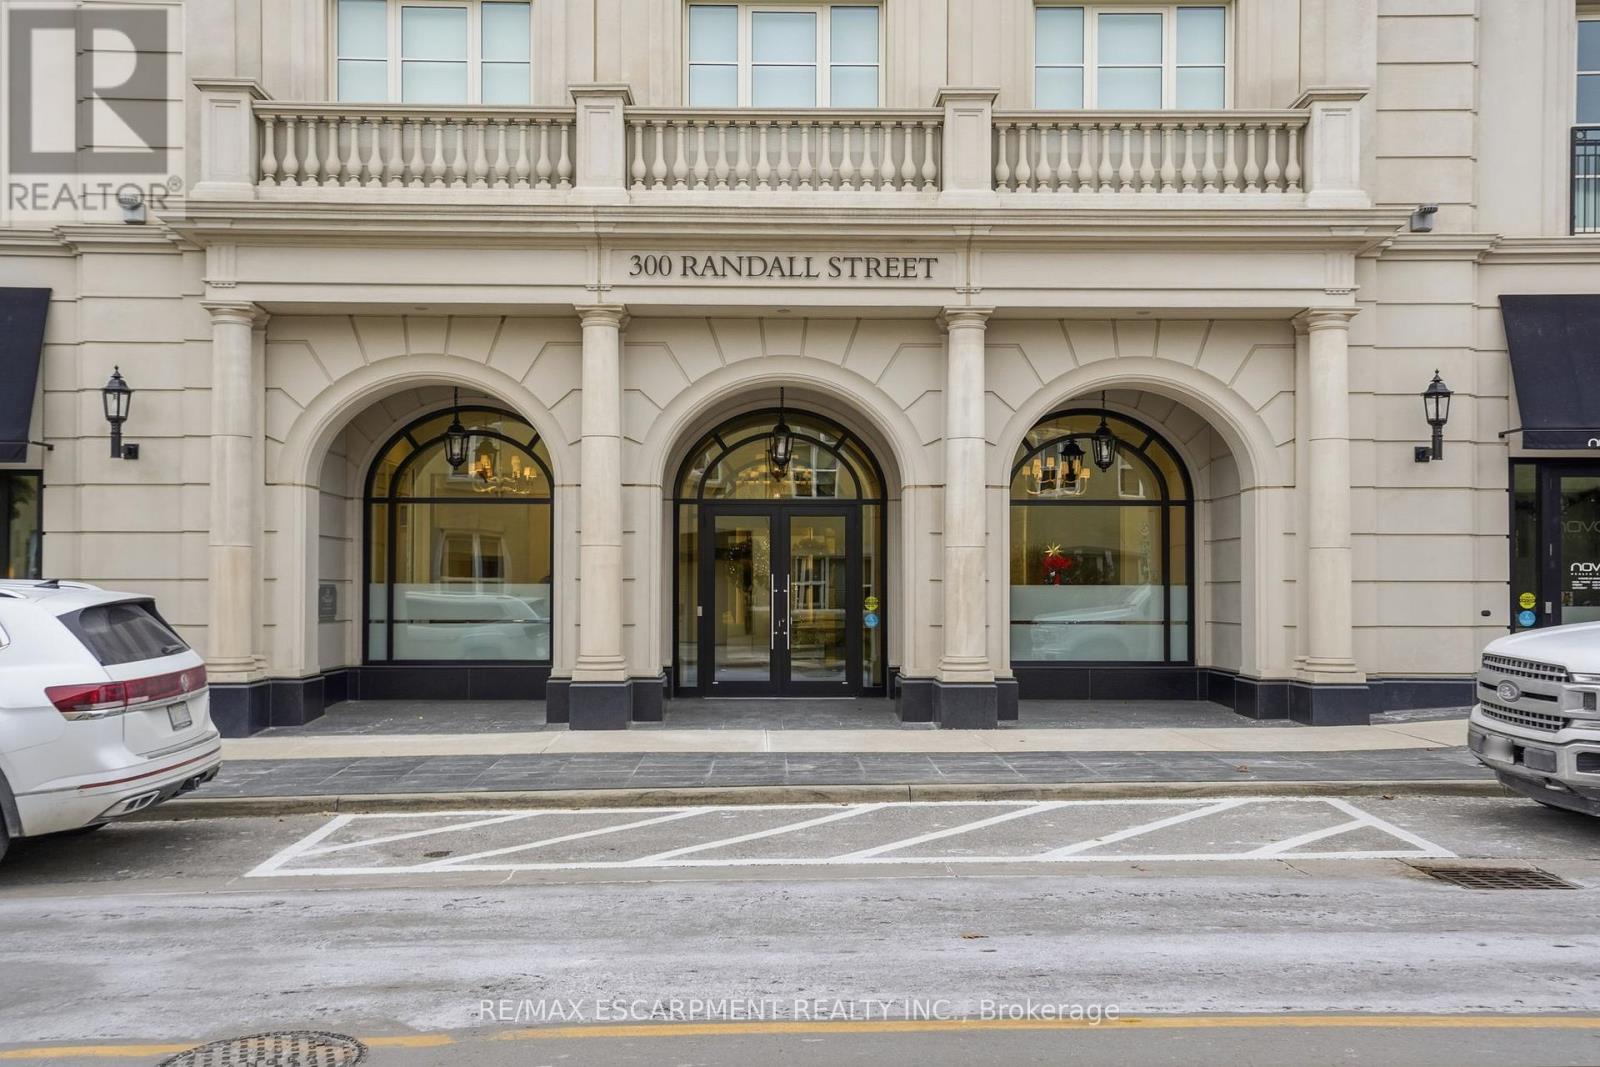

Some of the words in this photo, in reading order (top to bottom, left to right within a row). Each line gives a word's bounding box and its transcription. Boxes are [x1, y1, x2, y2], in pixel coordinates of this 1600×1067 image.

[629, 254, 672, 276] 300
[680, 255, 820, 278] RANDALL
[828, 256, 939, 279] STREET
